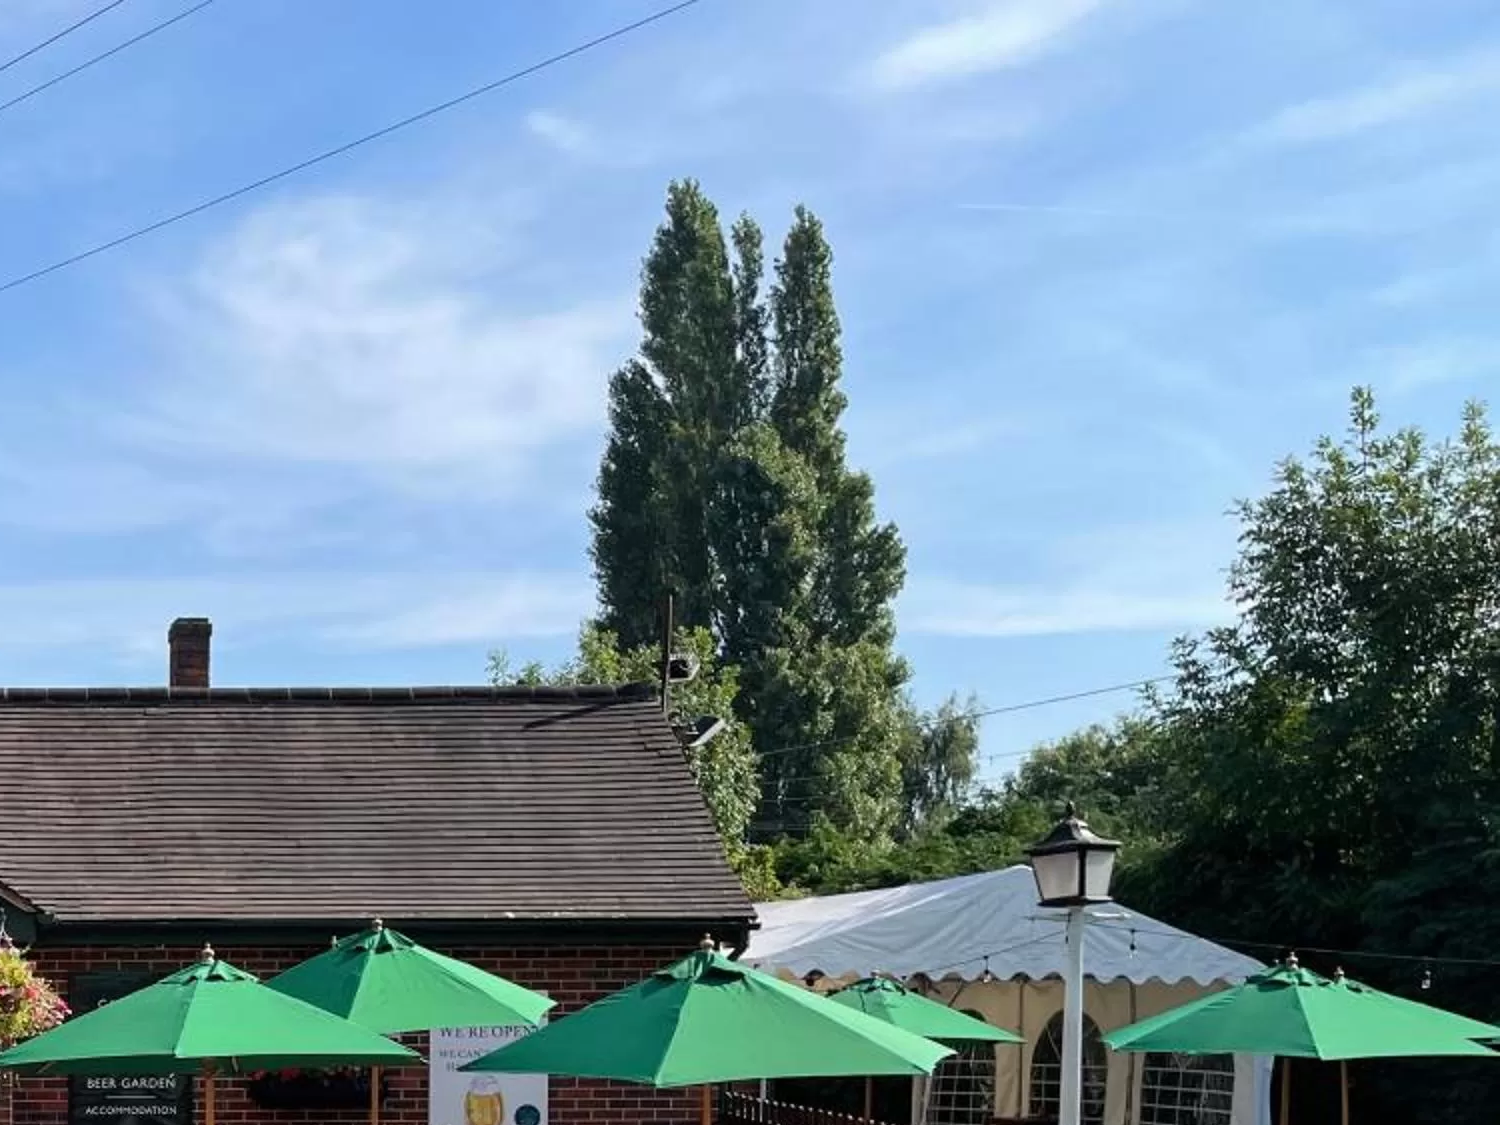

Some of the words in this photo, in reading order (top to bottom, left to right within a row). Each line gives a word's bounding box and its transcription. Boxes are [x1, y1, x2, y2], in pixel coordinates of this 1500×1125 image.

[87, 1077, 117, 1089] BEER
[121, 1077, 176, 1089] GARDEN
[85, 1105, 177, 1115] ACCOMMODATION
